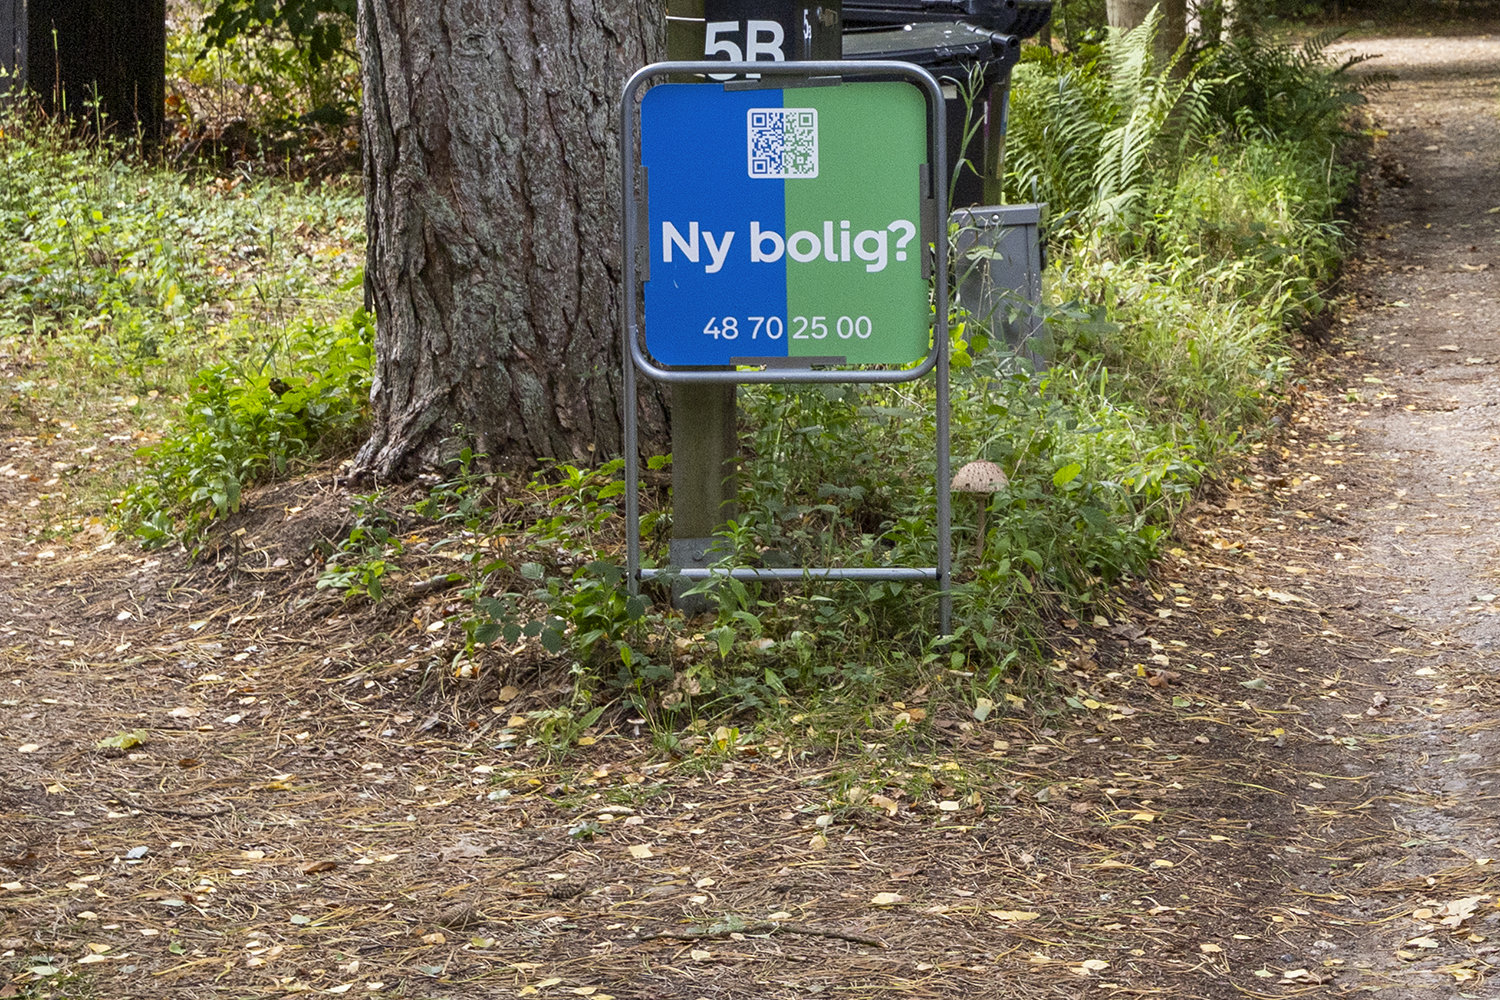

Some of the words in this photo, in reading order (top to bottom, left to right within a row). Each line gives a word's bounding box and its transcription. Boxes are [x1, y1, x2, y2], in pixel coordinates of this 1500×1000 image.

[704, 19, 786, 81] 5B
[661, 220, 735, 274] Ny
[750, 218, 917, 273] bolig?
[702, 316, 739, 340] 48
[748, 316, 783, 340] 70
[792, 315, 829, 340] 25
[835, 315, 873, 340] 00
